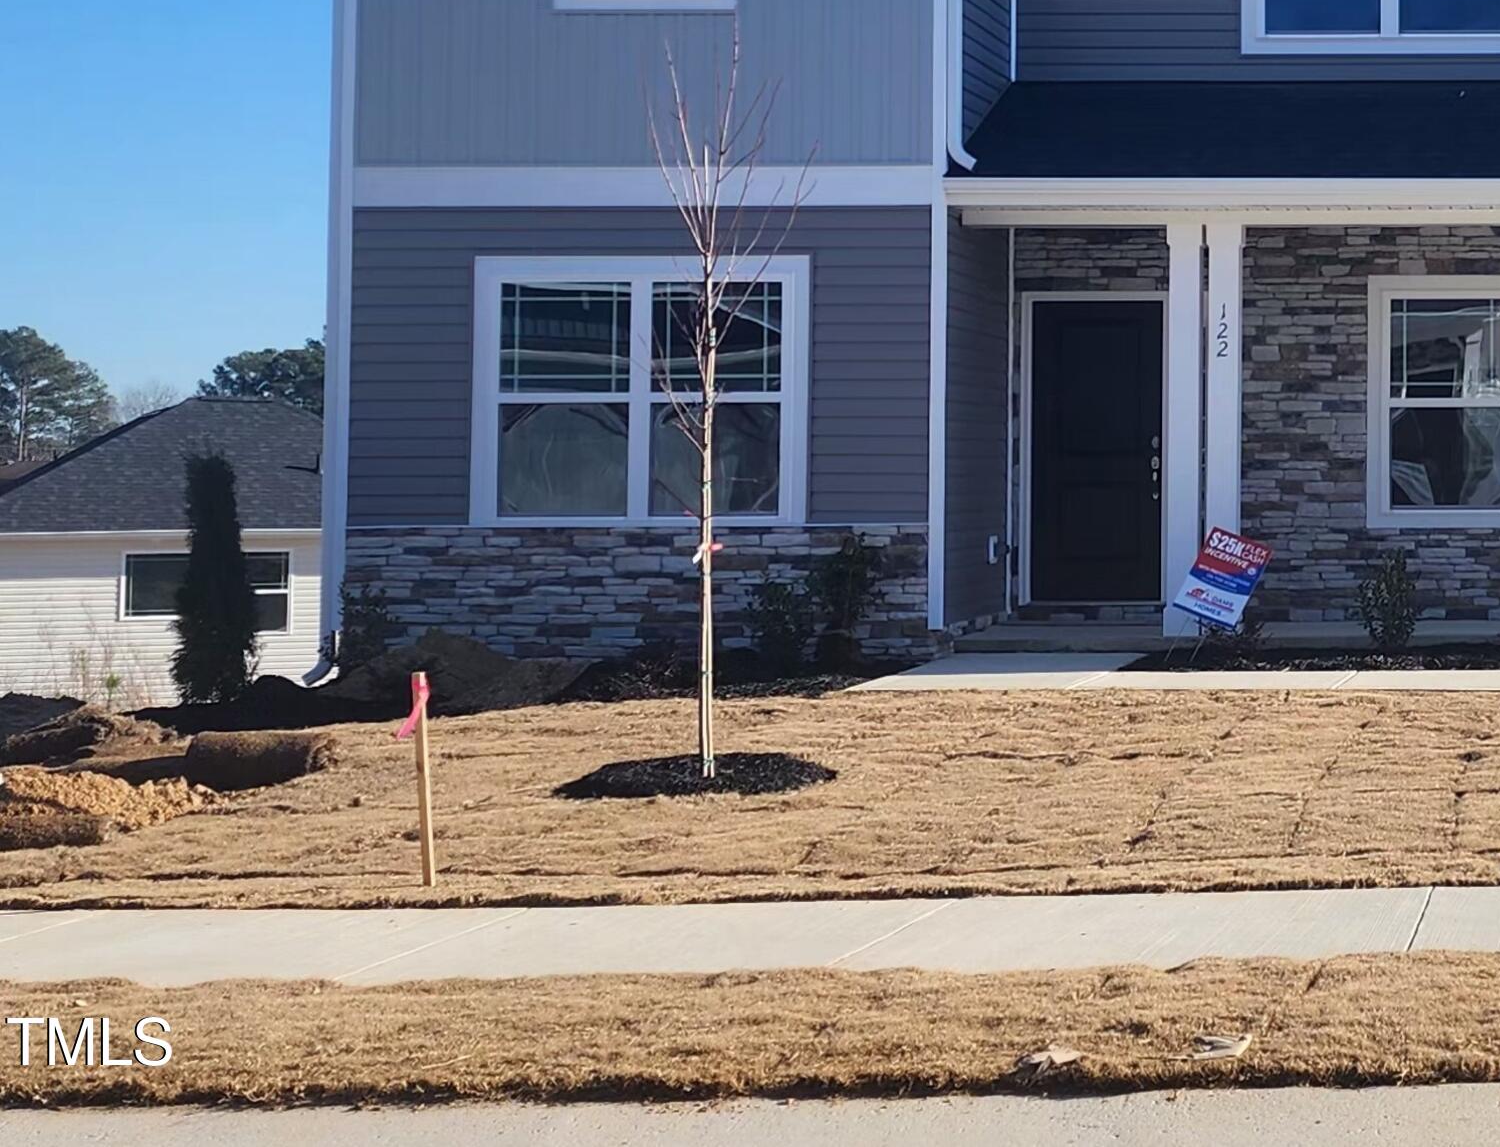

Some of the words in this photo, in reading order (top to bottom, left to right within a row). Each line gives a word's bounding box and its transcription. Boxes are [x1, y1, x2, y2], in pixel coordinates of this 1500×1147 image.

[1216, 303, 1228, 358] 122
[1209, 532, 1246, 557] $25K
[1245, 544, 1269, 558] FLEX
[1204, 547, 1249, 569] INCENTIVE
[1242, 551, 1265, 565] CASH
